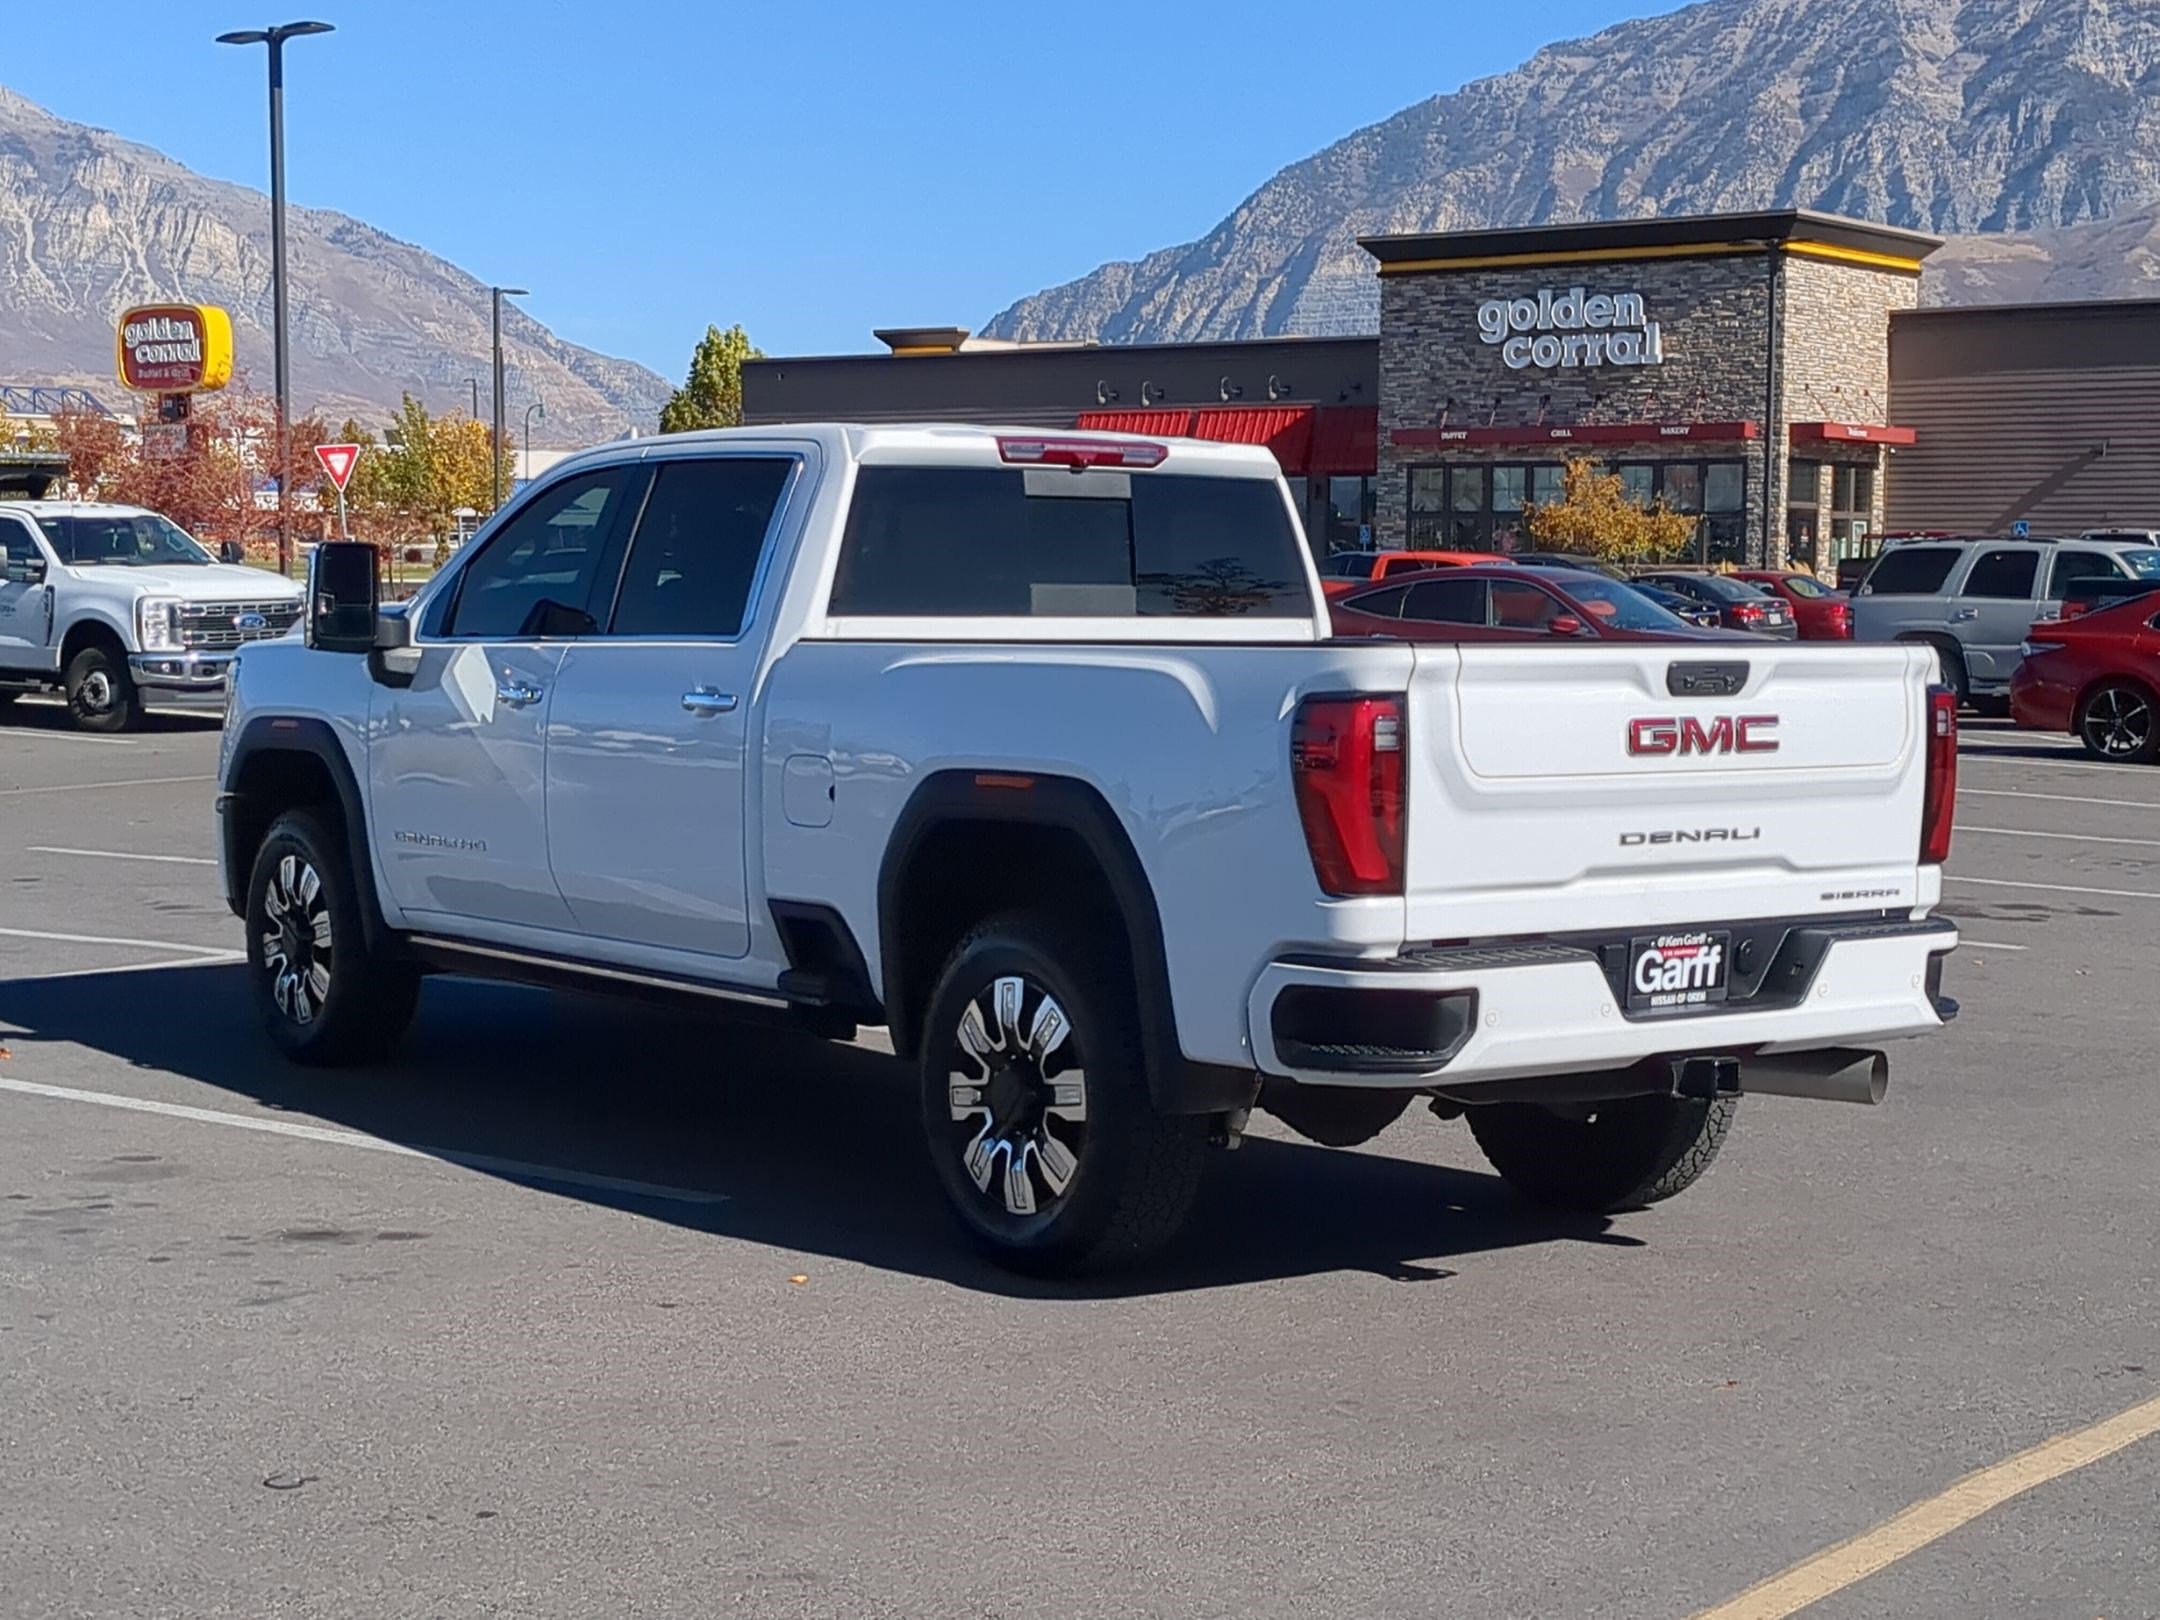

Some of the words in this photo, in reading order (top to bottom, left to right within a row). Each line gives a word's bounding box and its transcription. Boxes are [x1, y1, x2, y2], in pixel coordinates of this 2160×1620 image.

[1477, 287, 1647, 344] golden
[124, 317, 195, 348] golden
[1502, 321, 1664, 369] corral
[135, 338, 201, 364] corral
[1550, 429, 1573, 437] GRILL
[1660, 426, 1690, 435] BAKERY
[1627, 714, 1780, 757] GMC
[1619, 826, 1761, 847] DENALI
[1820, 888, 1900, 900] SIERRA
[1635, 944, 1722, 993] Garff
[1650, 994, 1676, 1007] NISSAN
